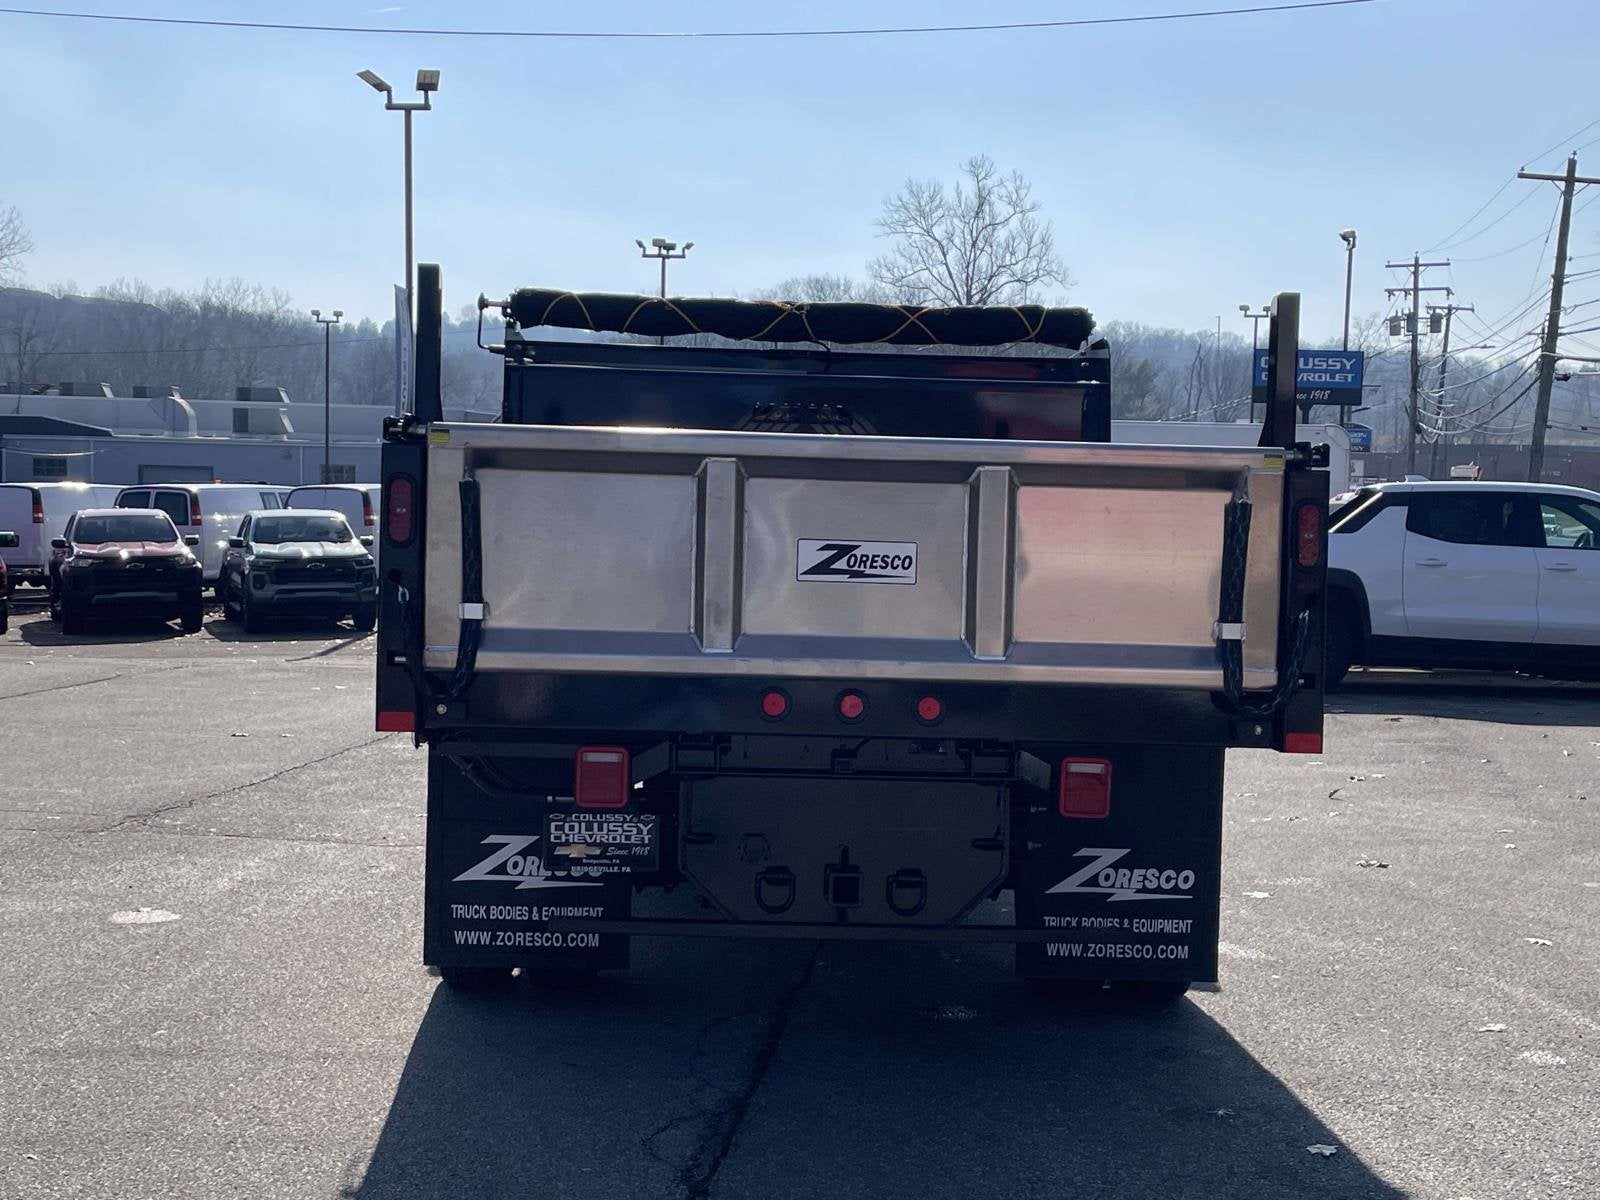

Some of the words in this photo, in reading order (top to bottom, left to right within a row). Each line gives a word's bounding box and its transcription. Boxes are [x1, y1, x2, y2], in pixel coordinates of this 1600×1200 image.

[1261, 357, 1356, 370] CUSSY
[1310, 390, 1331, 400] 1918
[800, 543, 913, 579] ZORESCO
[572, 813, 633, 822] COLUSSY
[550, 822, 654, 835] COLUSSY
[550, 834, 652, 843] CHEVROLET
[606, 847, 629, 856] Since
[631, 847, 650, 856] 1918
[1044, 847, 1195, 902] ZORESCO
[450, 904, 487, 919] TRUCK
[490, 905, 529, 920] BODIES
[532, 906, 539, 920] &
[1133, 918, 1193, 934] EQUIPMENT
[454, 930, 600, 947] WWW.ZORESCO.COM
[1046, 943, 1189, 960] WWW.ZORESCO.COM
